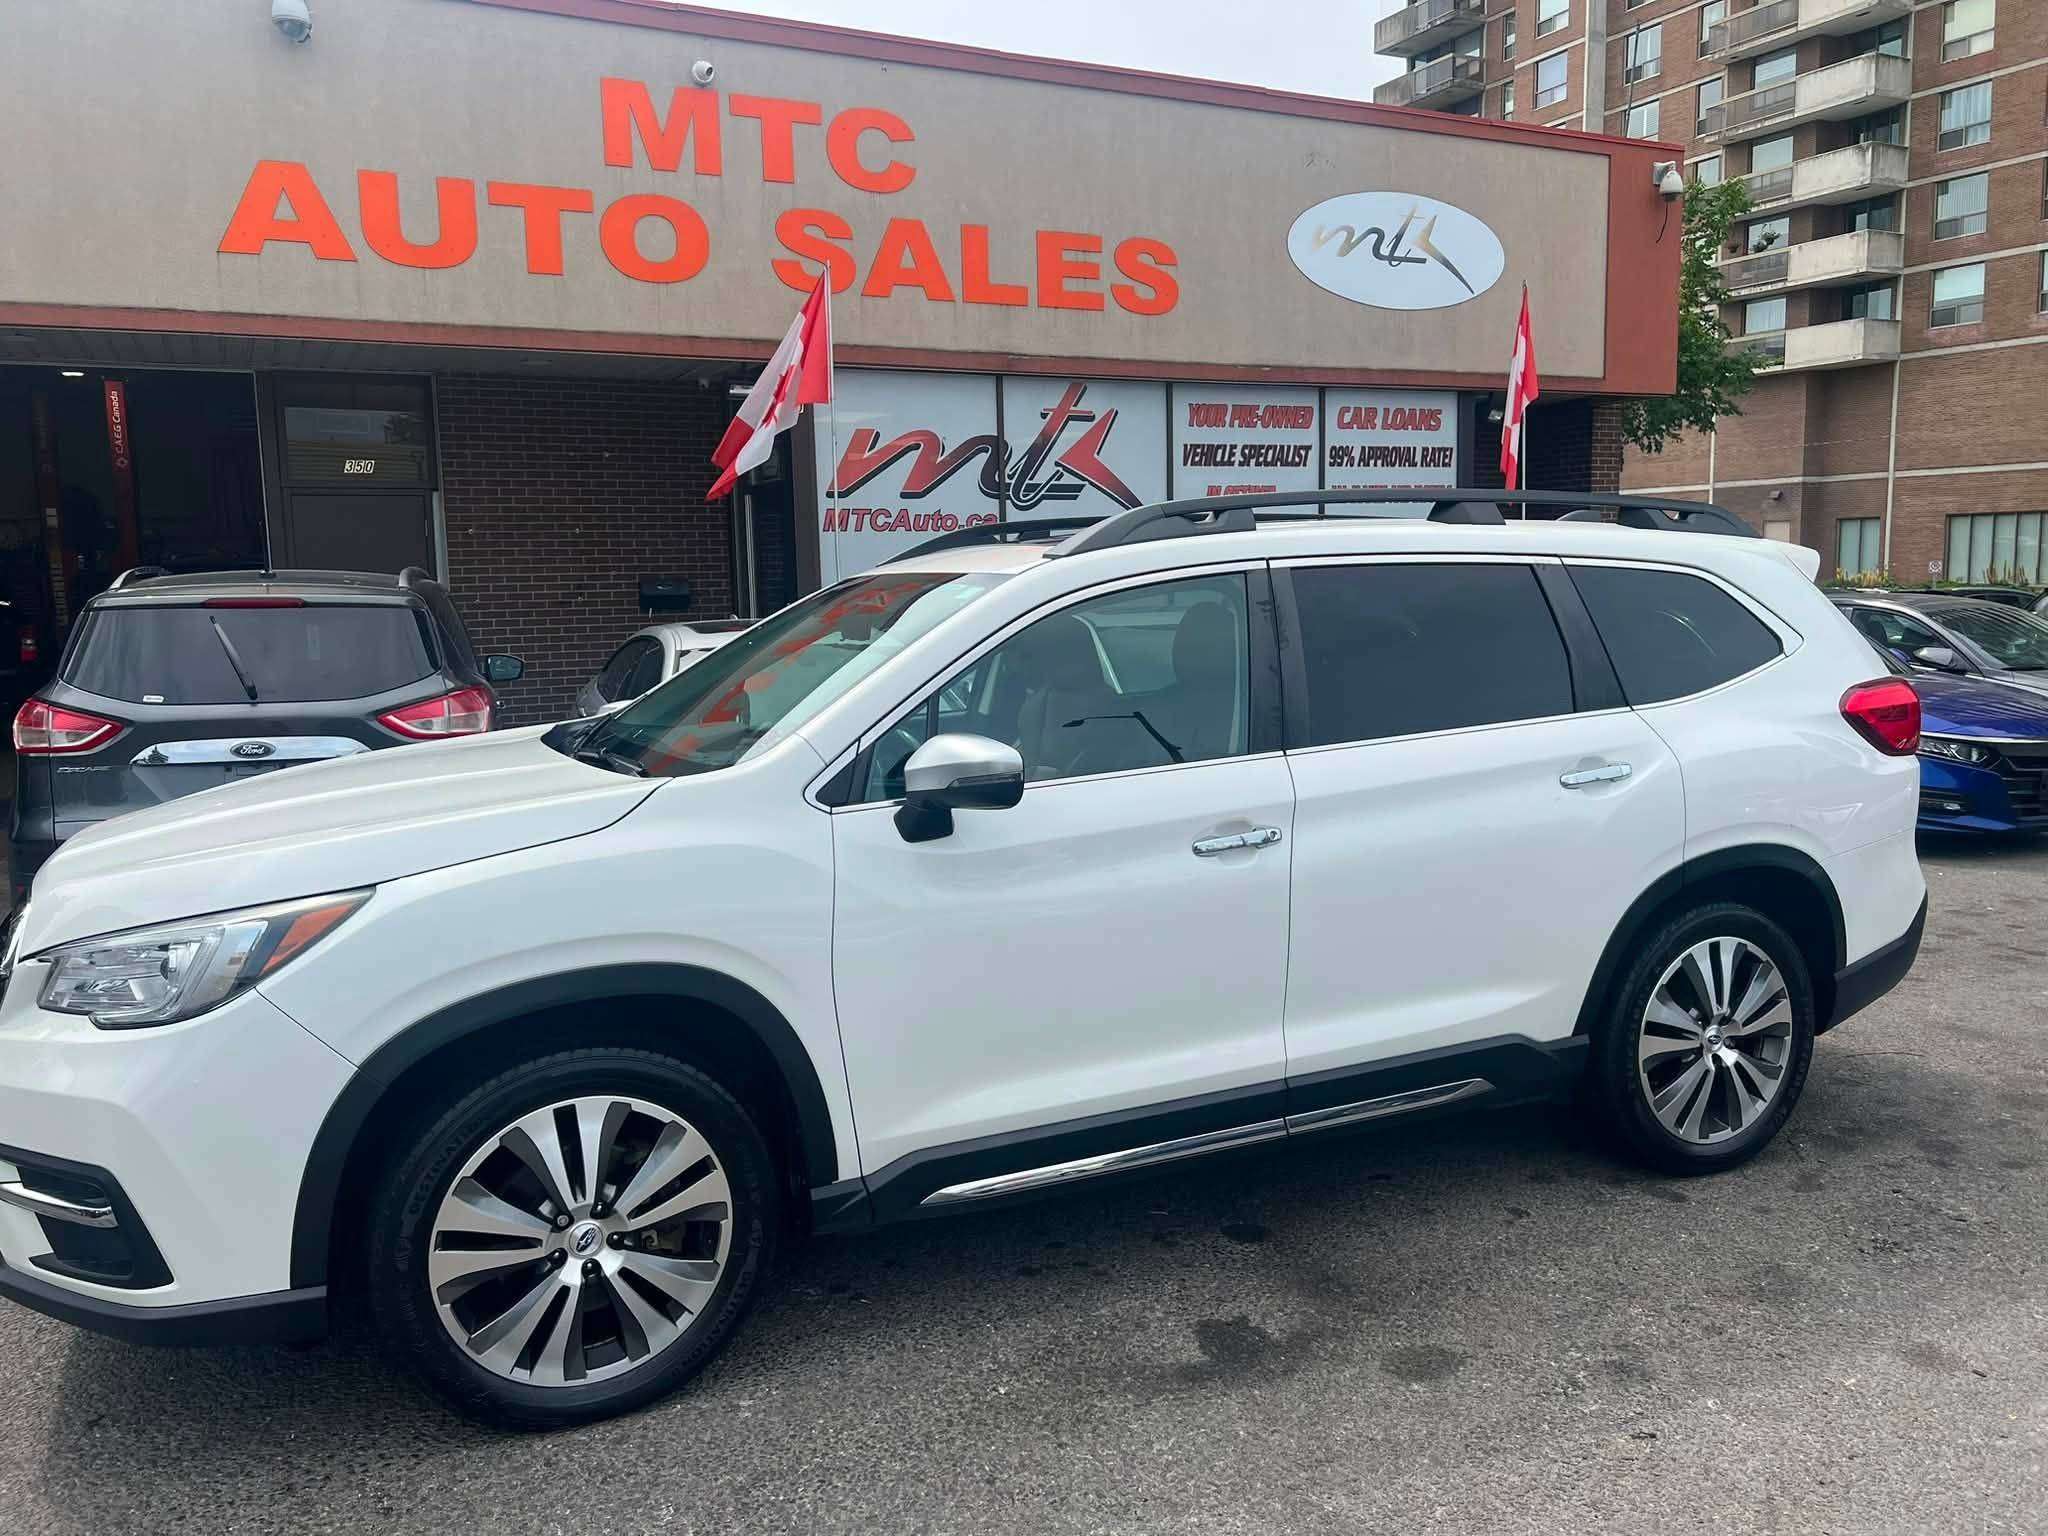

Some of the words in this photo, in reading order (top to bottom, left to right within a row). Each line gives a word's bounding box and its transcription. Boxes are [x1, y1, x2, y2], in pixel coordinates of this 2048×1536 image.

[601, 77, 916, 194] MTC
[218, 159, 710, 284] AUTO
[771, 207, 1180, 317] SALES
[110, 390, 121, 423] Canada
[1188, 403, 1228, 428] YOUR
[1229, 404, 1314, 429] PRE-OWNED
[1337, 406, 1378, 430] CAR
[1381, 407, 1442, 432] LOANS
[344, 460, 375, 473] 350
[1183, 443, 1238, 467] VEHICLE
[1238, 444, 1312, 467] SPECIALIST
[1328, 445, 1355, 468] 99%
[1357, 446, 1418, 468] APPROVAL
[1420, 446, 1454, 468] RATE!
[823, 508, 998, 532] MTCAuto.ca
[240, 744, 265, 755] Ford
